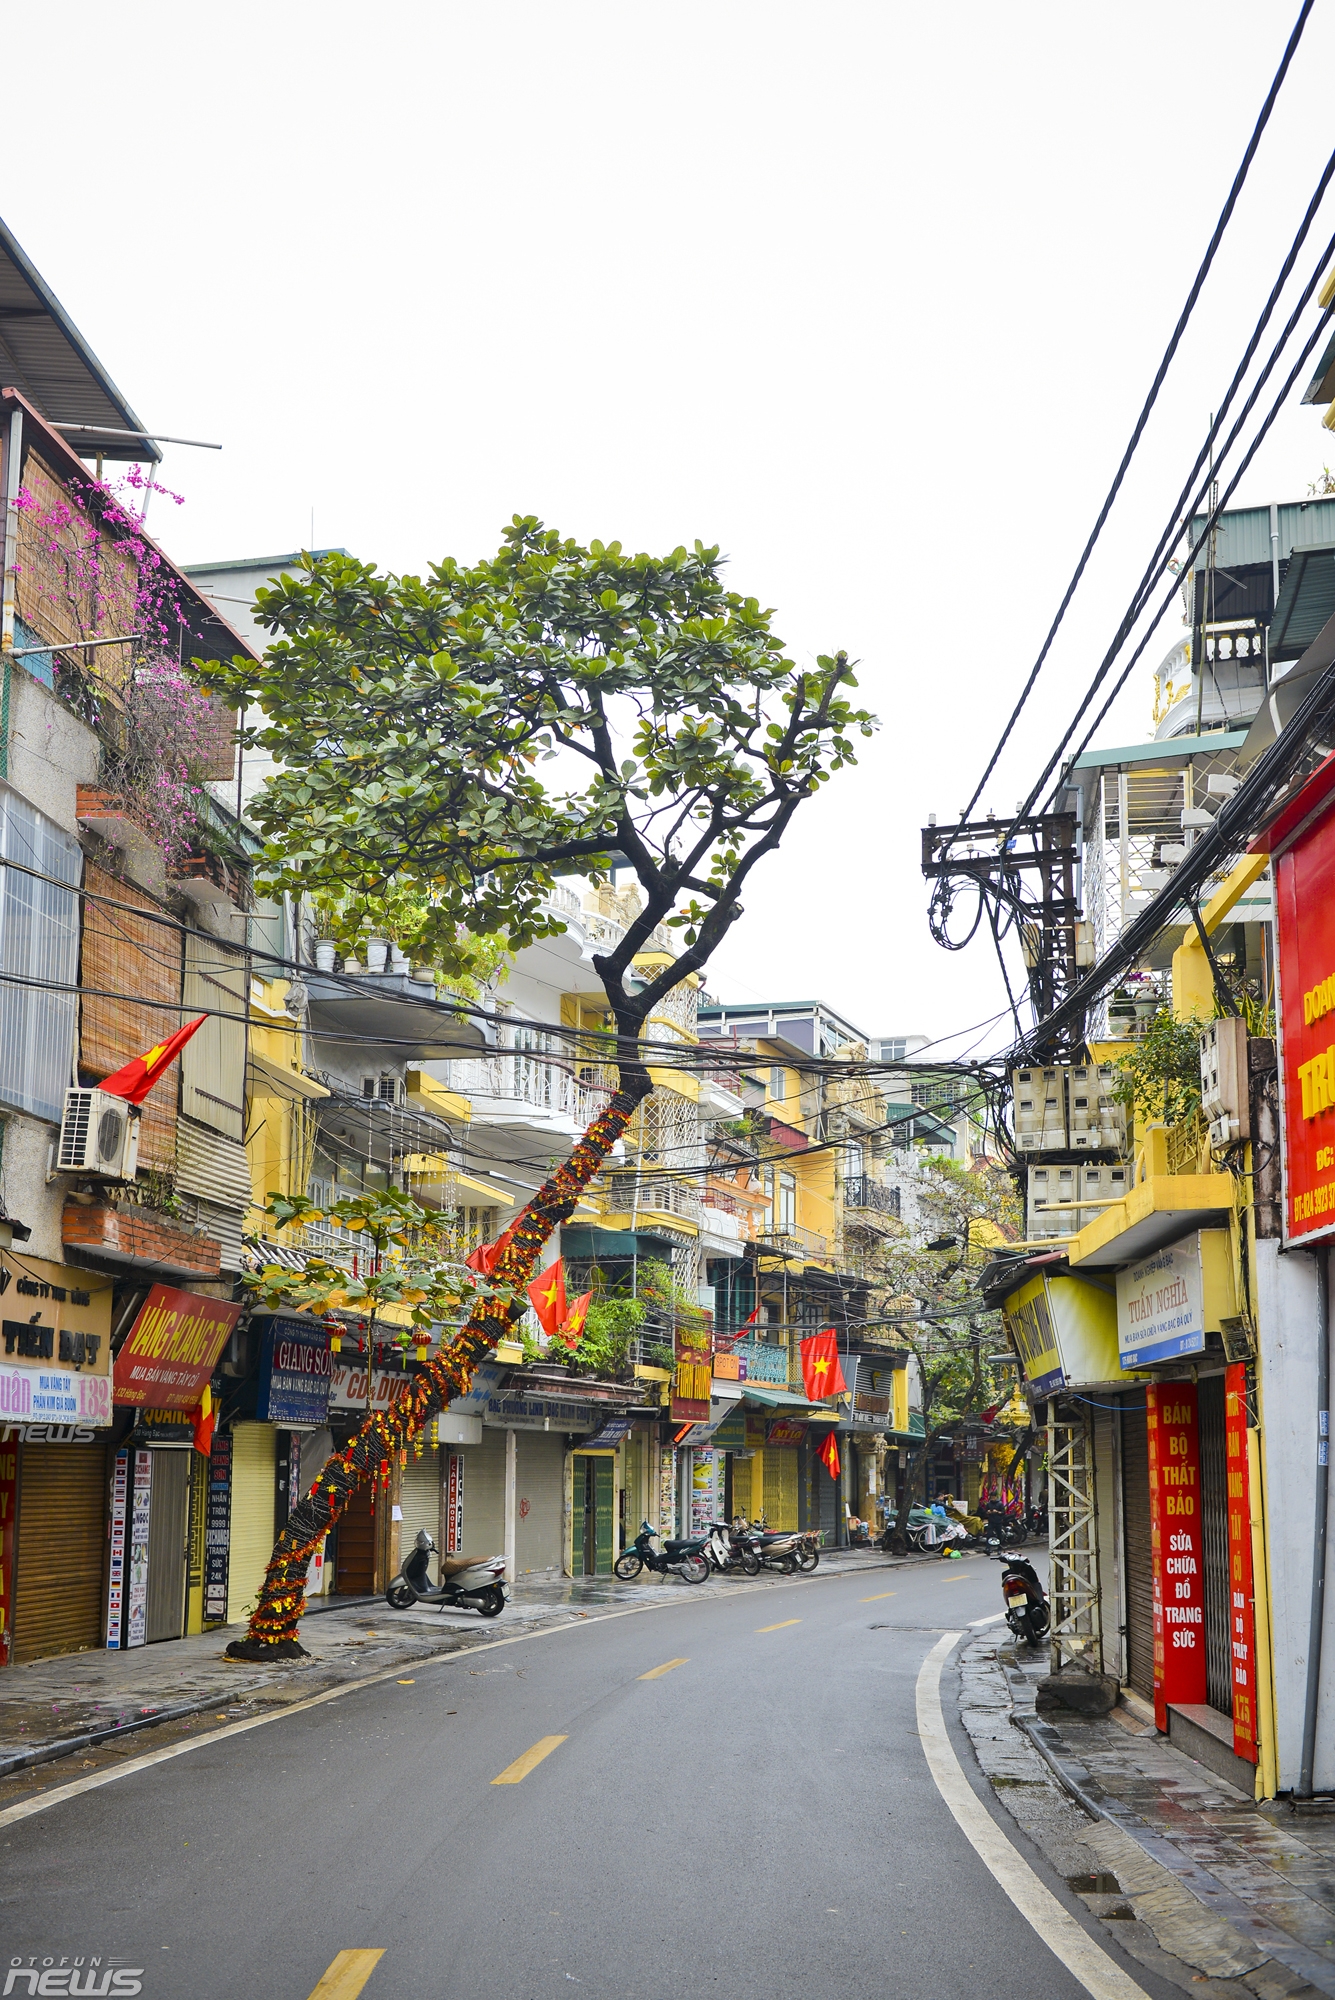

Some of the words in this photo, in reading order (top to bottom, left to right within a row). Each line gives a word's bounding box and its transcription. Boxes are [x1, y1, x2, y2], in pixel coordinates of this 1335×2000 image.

[40, 1282, 50, 1299] TY
[1128, 1284, 1153, 1325] TUẤN
[1155, 1275, 1189, 1315] NGHĨA
[2, 1311, 55, 1359] TIẾN
[129, 1295, 178, 1359] VÀNG
[161, 1305, 216, 1366] HOÀNG
[202, 1312, 233, 1368] TÍN
[279, 1341, 313, 1373] GIANG
[39, 1375, 50, 1390] MUA
[129, 1365, 148, 1381] MUA
[145, 1366, 162, 1384] BÁN
[158, 1368, 179, 1385] VÀNG
[175, 1370, 192, 1387] TÂY
[346, 1373, 369, 1399] CD
[78, 1376, 109, 1418] 132
[1162, 1401, 1192, 1425] BÁN
[1169, 1432, 1188, 1460] BỘ
[1228, 1426, 1240, 1457] BÁN
[1162, 1460, 1196, 1485] THẤT
[1228, 1466, 1243, 1498] VÀNG
[1166, 1489, 1194, 1516] BẢO
[210, 1519, 227, 1528] 9999
[1230, 1508, 1242, 1541] TÂY
[208, 1547, 227, 1556] TRANG
[1169, 1529, 1193, 1551] SỬA
[210, 1571, 223, 1581] 24K
[1166, 1555, 1197, 1575] CHỮA
[1233, 1550, 1242, 1582] CŨ
[1175, 1577, 1191, 1599] ĐỒ
[1233, 1591, 1245, 1609] BÁN
[1165, 1606, 1202, 1624] TRANG
[1235, 1614, 1244, 1634] BỘ
[1172, 1627, 1196, 1649] SỨC
[1232, 1634, 1248, 1661] THẤT
[1235, 1662, 1247, 1686] BẢO
[1234, 1693, 1250, 1724] 175
